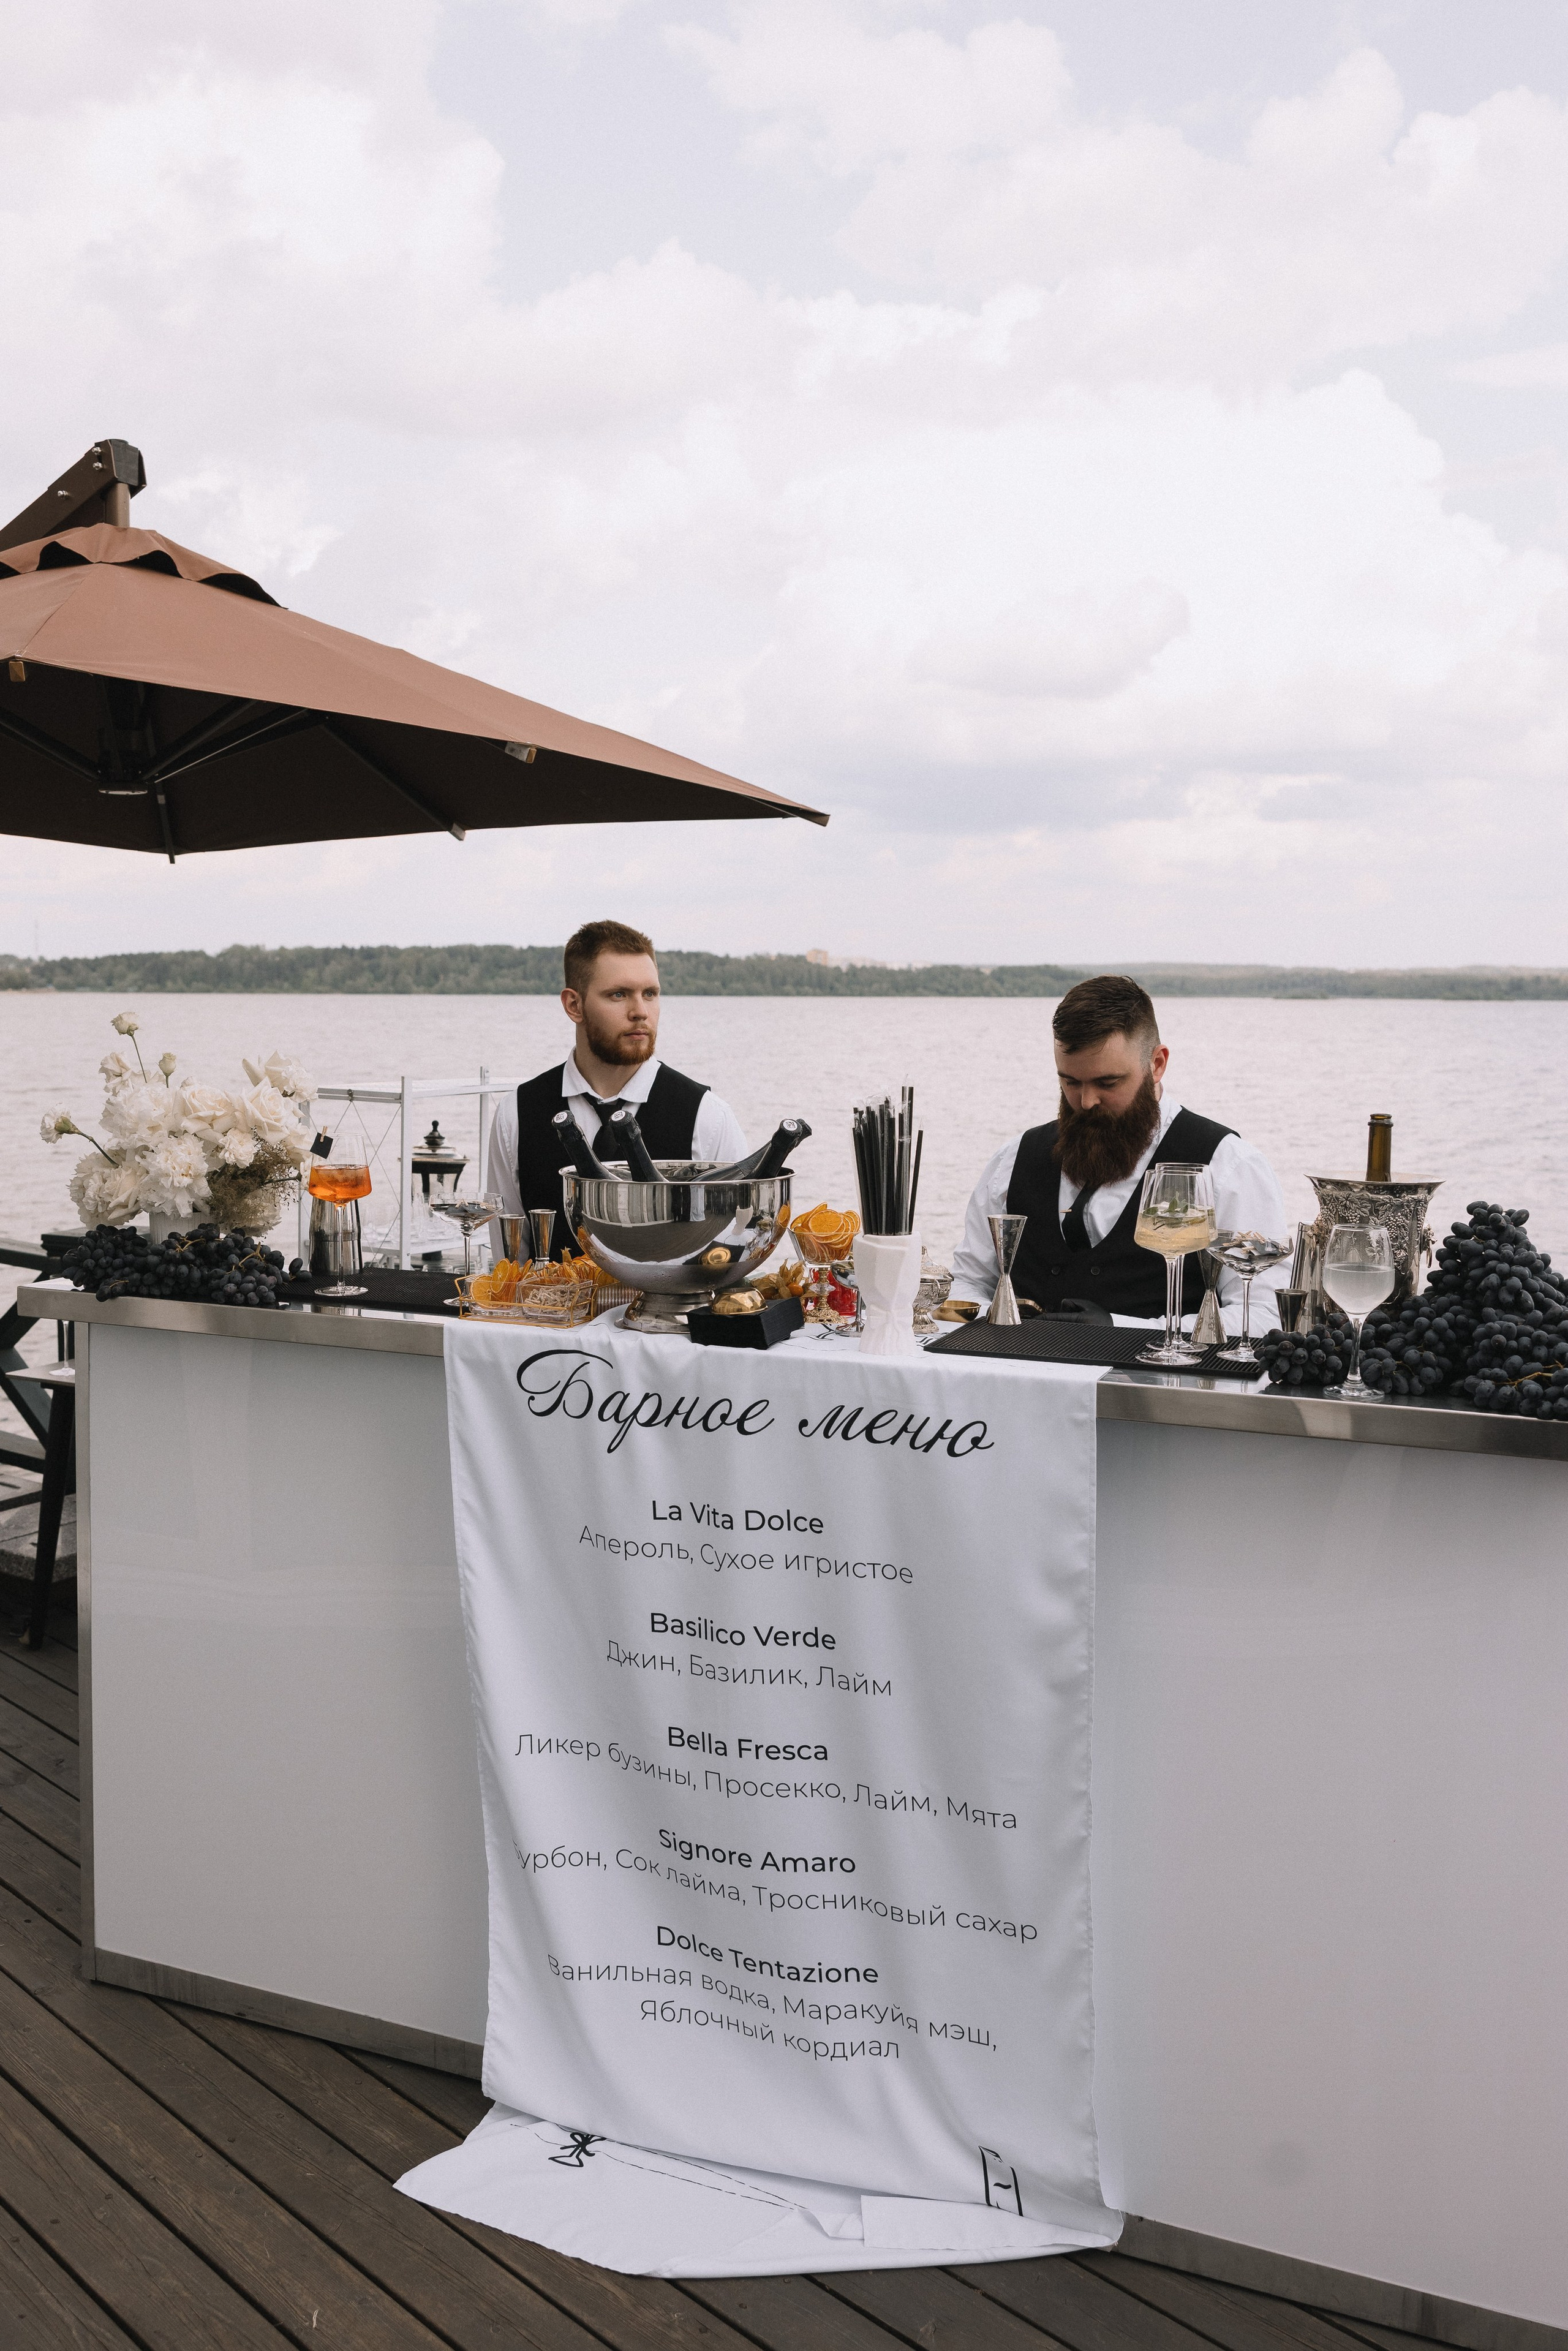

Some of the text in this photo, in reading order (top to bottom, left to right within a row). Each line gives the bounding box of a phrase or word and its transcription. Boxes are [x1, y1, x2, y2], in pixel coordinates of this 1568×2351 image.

[516, 1348, 995, 1459] Барное меню
[652, 1500, 824, 1534] La Vita Dolce
[579, 1525, 913, 1585] Апероль, Сухое игристое
[650, 1612, 837, 1651] Basilico Verde
[606, 1639, 891, 1696] Джин, Базилик, Лайм
[668, 1726, 829, 1761] Bella Fresca
[514, 1734, 1017, 1829] Ликер бузины, Просекко, Лайм, Мята
[658, 1828, 856, 1874] Signore Amaro
[616, 1848, 662, 1877] Сок
[666, 1866, 746, 1906] лайма,
[751, 1885, 946, 1927] Тросниковый
[956, 1912, 1038, 1944] сахар
[657, 1925, 879, 1983] Dolce Tentazione
[547, 1953, 997, 2052] Ванильная водка, Маракуйя мэш,
[640, 1999, 899, 2062] Яблочный кордиал
